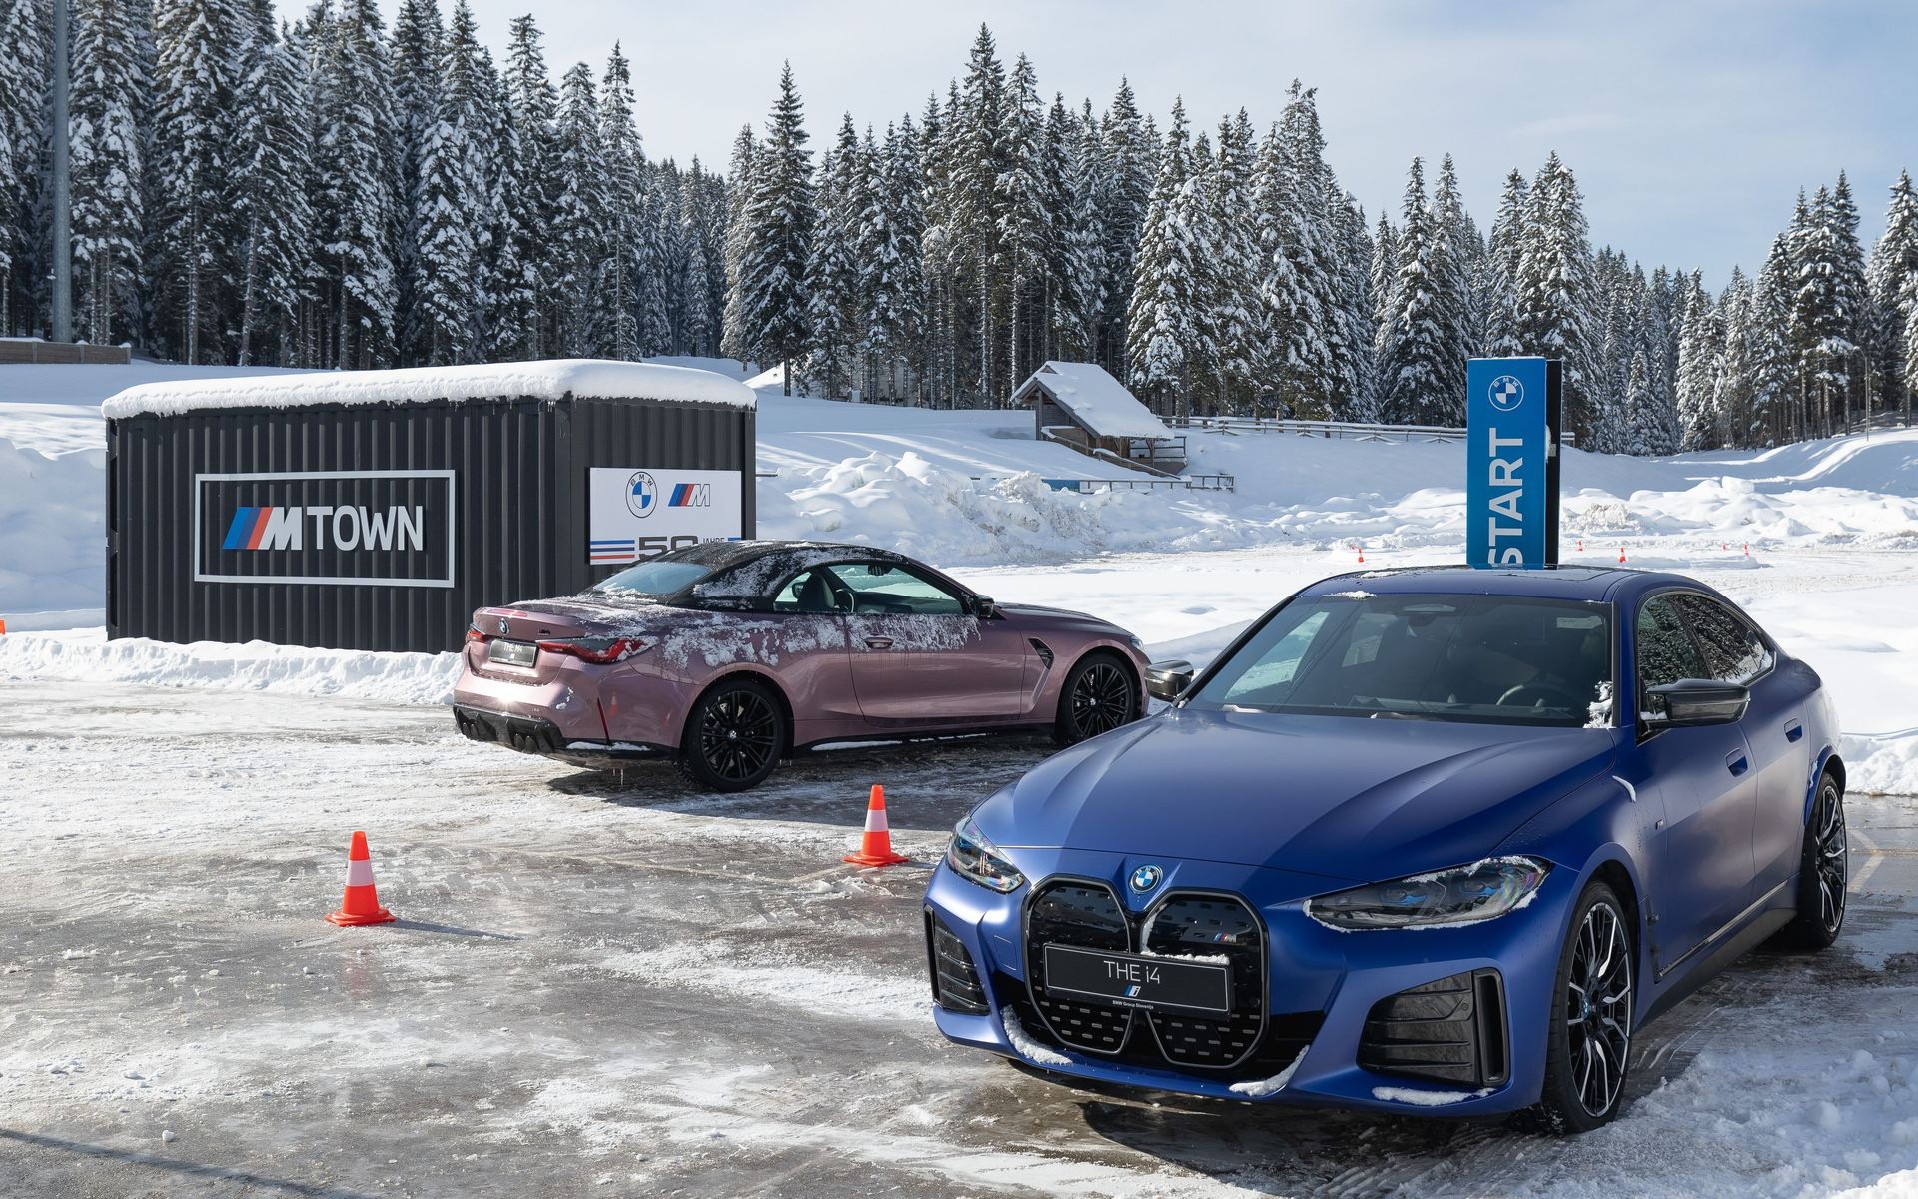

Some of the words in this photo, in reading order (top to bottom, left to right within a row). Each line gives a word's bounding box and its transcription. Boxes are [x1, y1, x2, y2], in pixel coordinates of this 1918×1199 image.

[1488, 427, 1523, 567] START
[306, 505, 424, 551] TOWN
[1103, 960, 1141, 982] THE
[1146, 966, 1160, 984] i4
